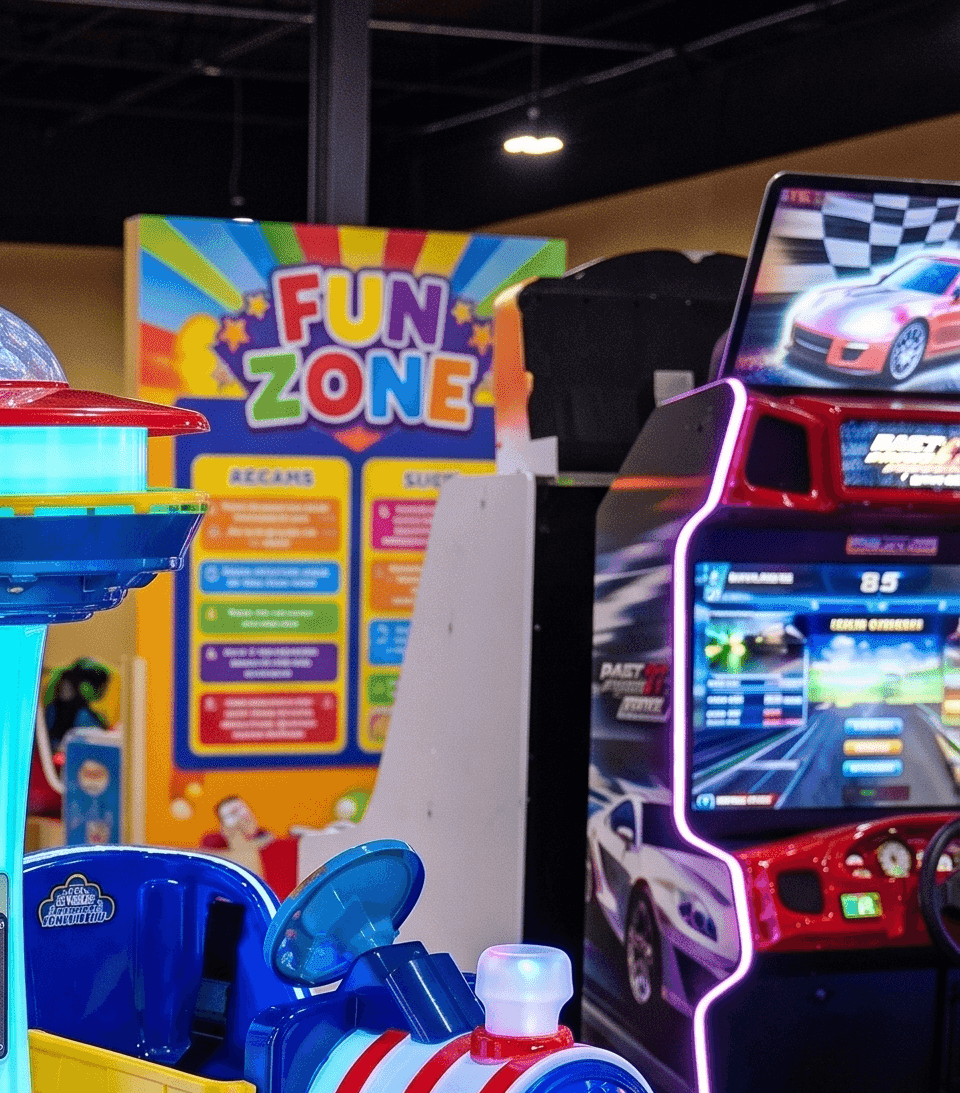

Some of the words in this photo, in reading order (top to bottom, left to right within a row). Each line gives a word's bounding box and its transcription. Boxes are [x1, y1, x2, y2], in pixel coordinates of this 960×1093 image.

[272, 265, 449, 350] FUN
[243, 346, 478, 432] ZONE
[860, 571, 900, 594] 85
